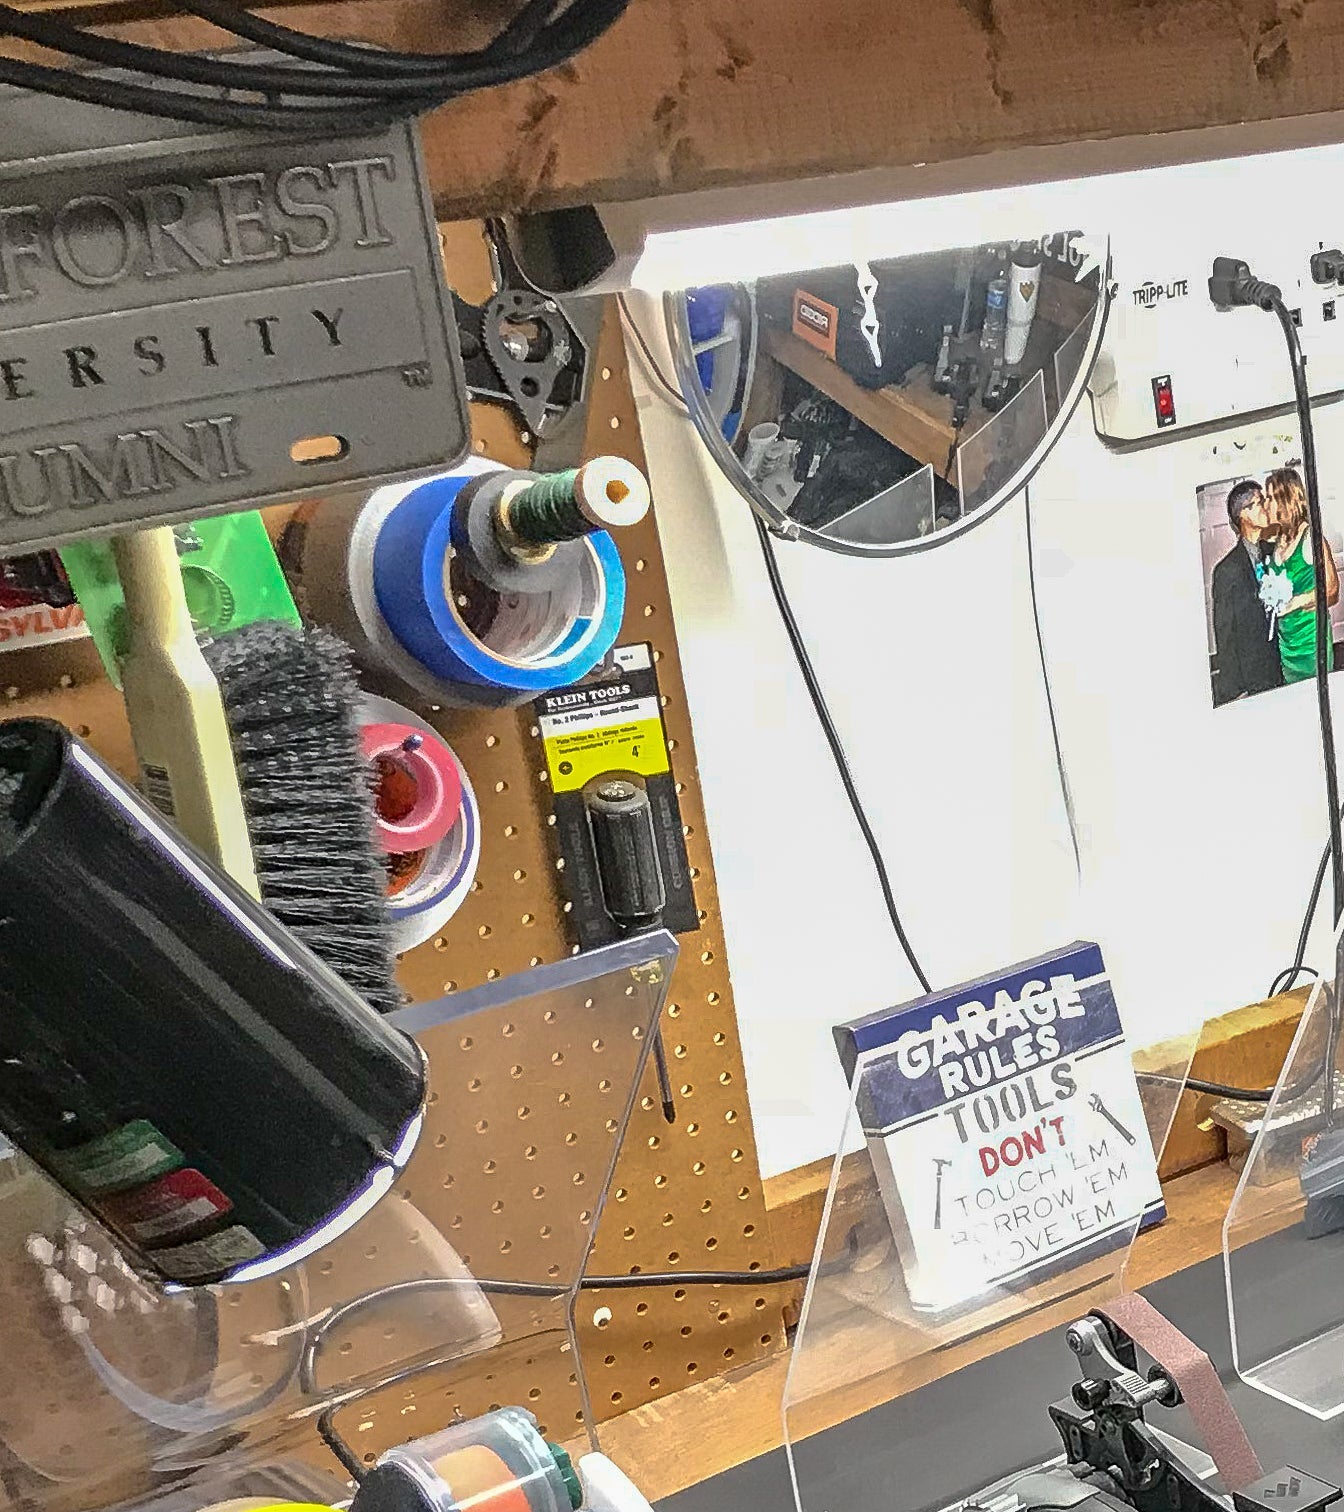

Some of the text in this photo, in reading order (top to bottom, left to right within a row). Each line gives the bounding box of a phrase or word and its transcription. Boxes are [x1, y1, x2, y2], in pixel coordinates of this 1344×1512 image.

[0, 153, 397, 303] FOREST
[545, 684, 631, 708] KLEIN TOOLS
[898, 974, 1086, 1080] GARAGE
[938, 1025, 1061, 1100] RULES
[944, 1062, 1078, 1144] TOOLS
[978, 1116, 1066, 1178] DON'T
[1085, 1161, 1128, 1194] 'EM
[954, 1163, 1057, 1217] TOUCH
[1072, 1199, 1116, 1232] 'EM
